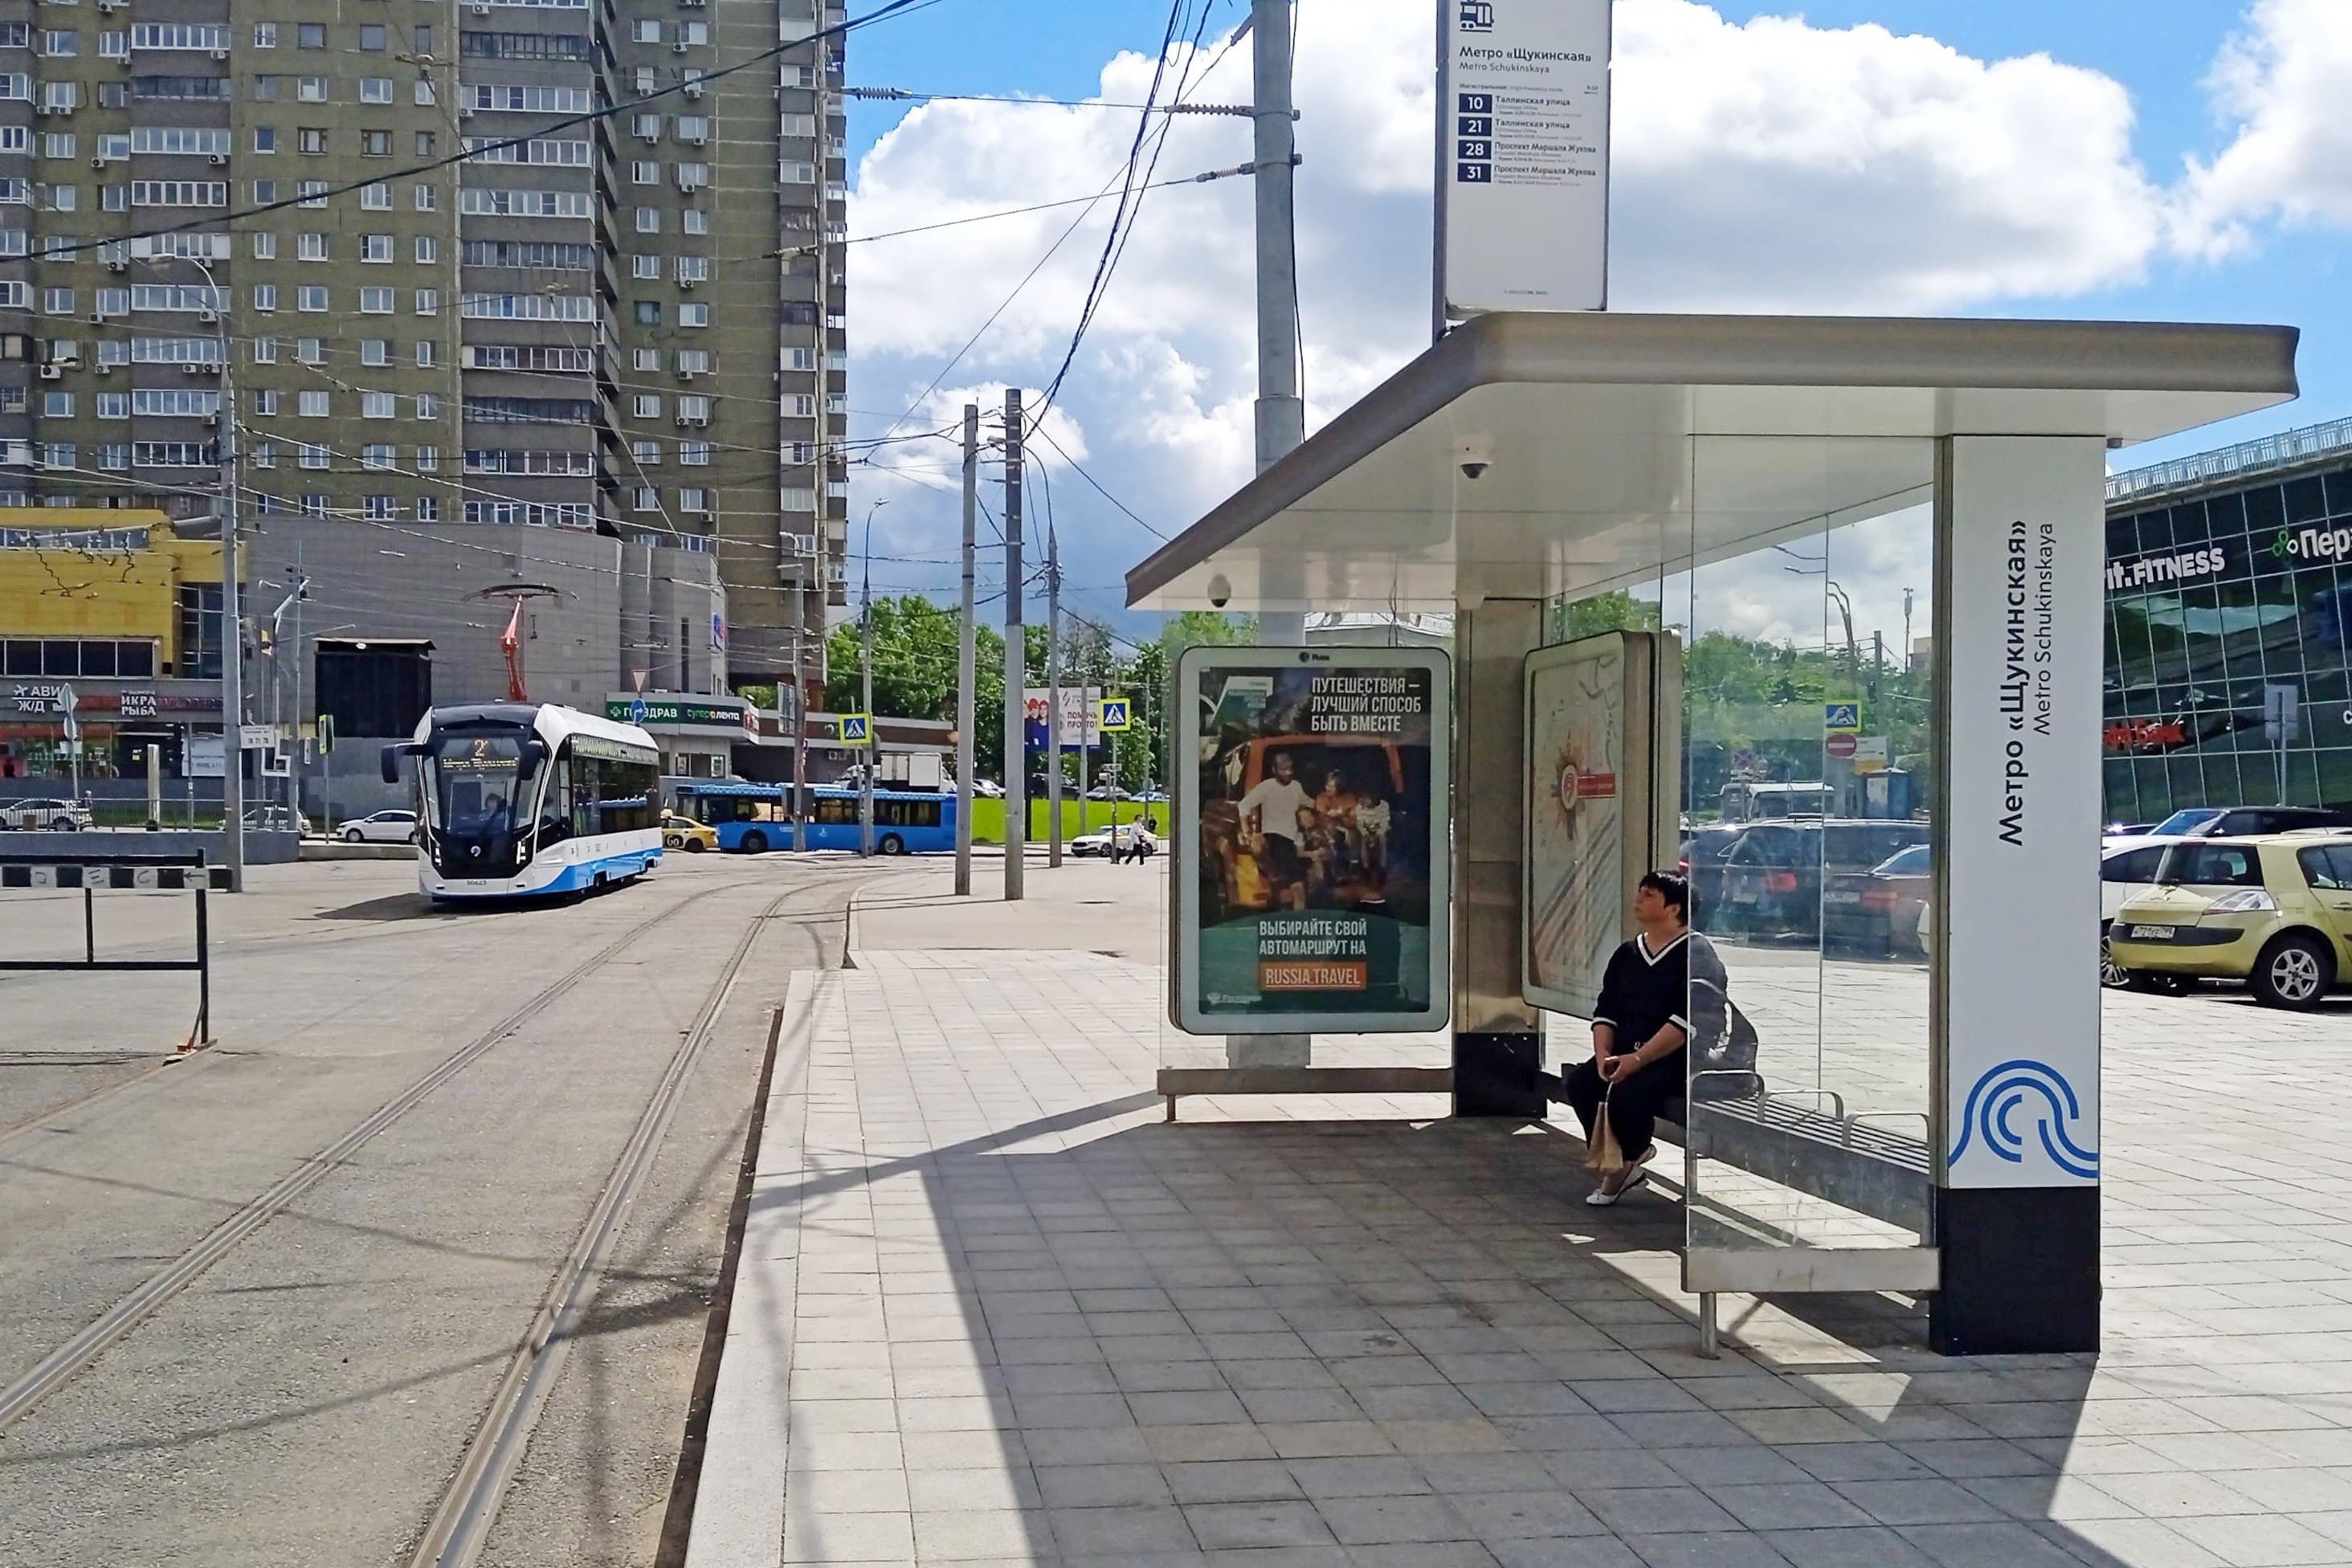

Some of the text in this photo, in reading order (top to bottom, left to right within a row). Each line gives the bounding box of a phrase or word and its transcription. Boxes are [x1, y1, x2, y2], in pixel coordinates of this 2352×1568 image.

[1459, 46, 1592, 63] Метро «Щукинская»
[1459, 62, 1550, 75] Metro Schukinskaya
[1468, 96, 1483, 110] 10
[1496, 96, 1570, 107] Таллинская улица
[1468, 120, 1482, 133] 21
[1496, 119, 1543, 129] Таллинская
[1545, 121, 1570, 130] улица
[1465, 143, 1484, 157] 28
[1494, 141, 1529, 151] Проспект
[1530, 143, 1566, 153] Маршала
[1568, 145, 1596, 154] Жукова
[1467, 166, 1481, 179] 31
[1494, 165, 1529, 174] Проспект
[1530, 166, 1566, 176] Маршала
[1567, 168, 1596, 178] Жукова
[2300, 528, 2352, 561] Пер
[2105, 547, 2225, 590] it.FITNESS
[2033, 523, 2057, 735] Metro Schukinskaya
[1311, 676, 1406, 694] ПУТЕШЕСТВИЯ
[1999, 520, 2030, 847] Метро «Щукинская»
[30, 685, 63, 696] АВИ
[18, 700, 46, 713] Ж/Д
[121, 696, 157, 706] ИКРА
[1310, 693, 1422, 713] ЛУЧШИЙ СПОСОБ
[121, 706, 157, 717] РЫБА
[623, 707, 678, 718] ГЗДРАВ
[1068, 721, 1097, 729] ПРОТО!
[1311, 715, 1402, 732] БЫТЬ ВМЕСТЕ
[666, 835, 680, 847] Go
[1259, 918, 1367, 936] ВЫБИРАЙТЕ СВОЙ
[1259, 939, 1367, 955] АВТОМАРШРУТ НА
[1265, 967, 1361, 985] RUSSIA.TRAVEL
